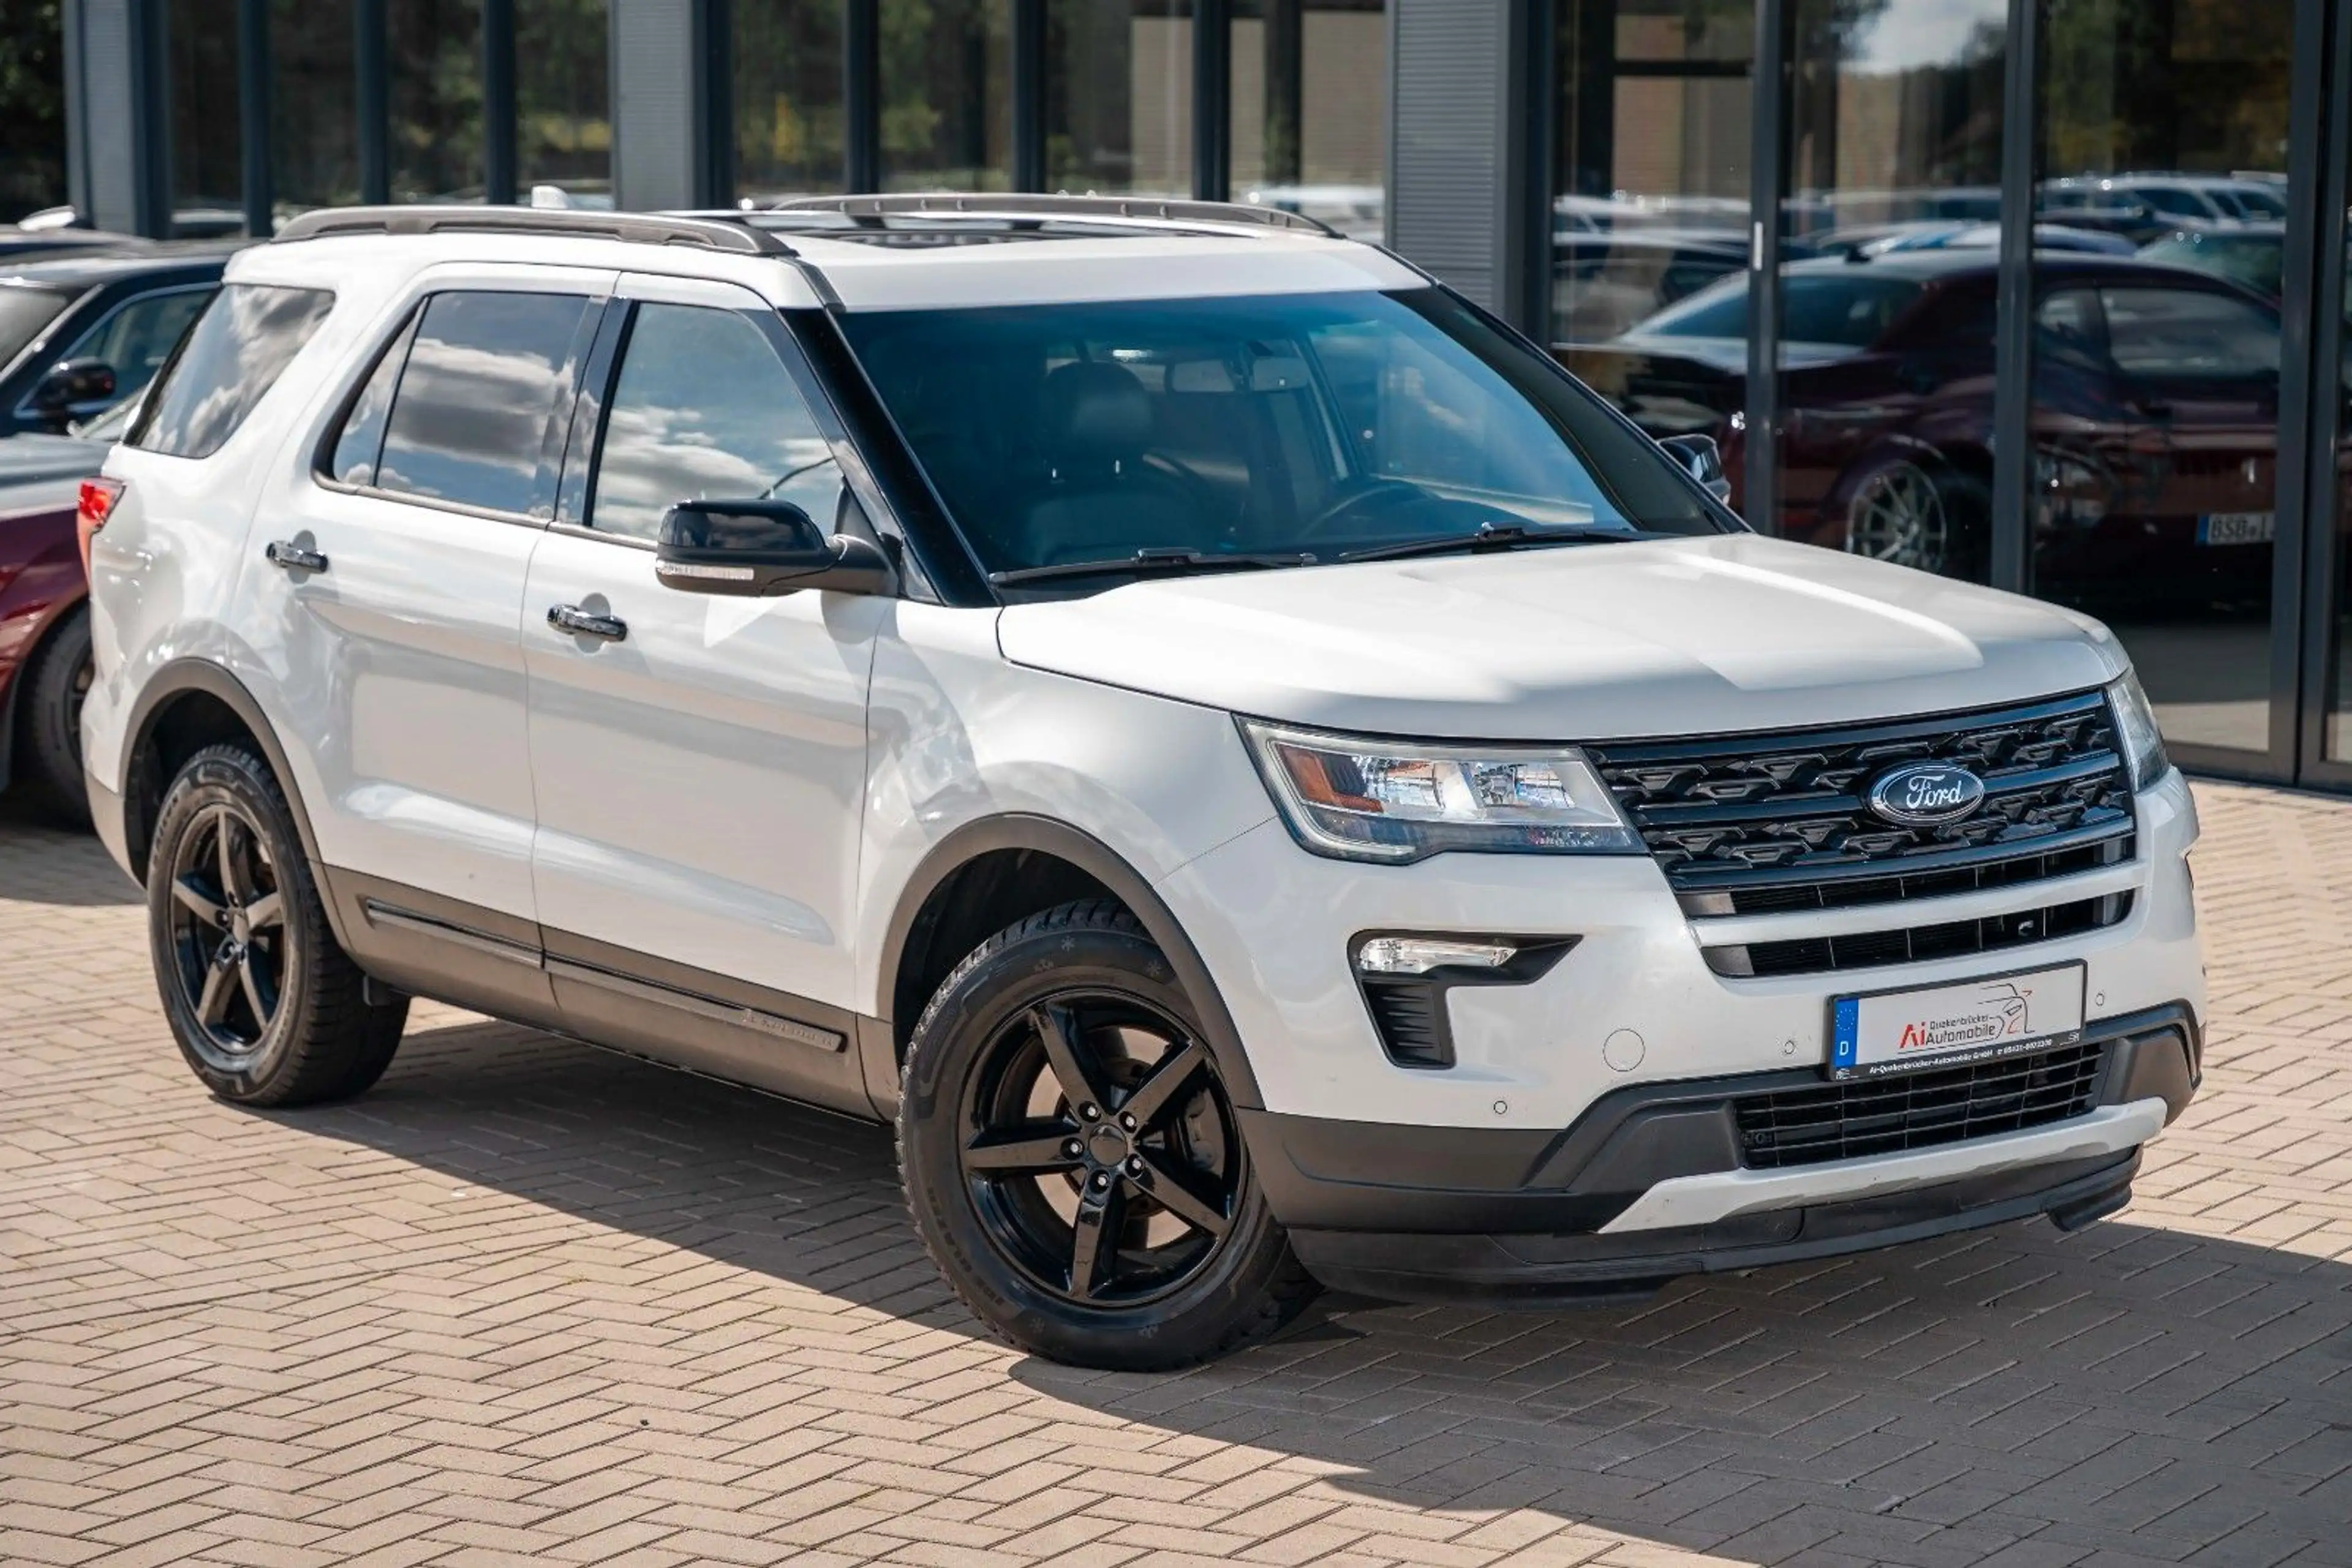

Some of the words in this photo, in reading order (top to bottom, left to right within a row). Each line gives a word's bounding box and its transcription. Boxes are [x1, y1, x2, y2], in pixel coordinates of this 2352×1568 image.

[1906, 774, 1964, 809] Ford
[1929, 1014, 1989, 1030] Quakenbrücker
[1899, 1021, 1926, 1049] Ai
[1926, 1024, 1996, 1045] Automobile
[1839, 1040, 1850, 1057] D
